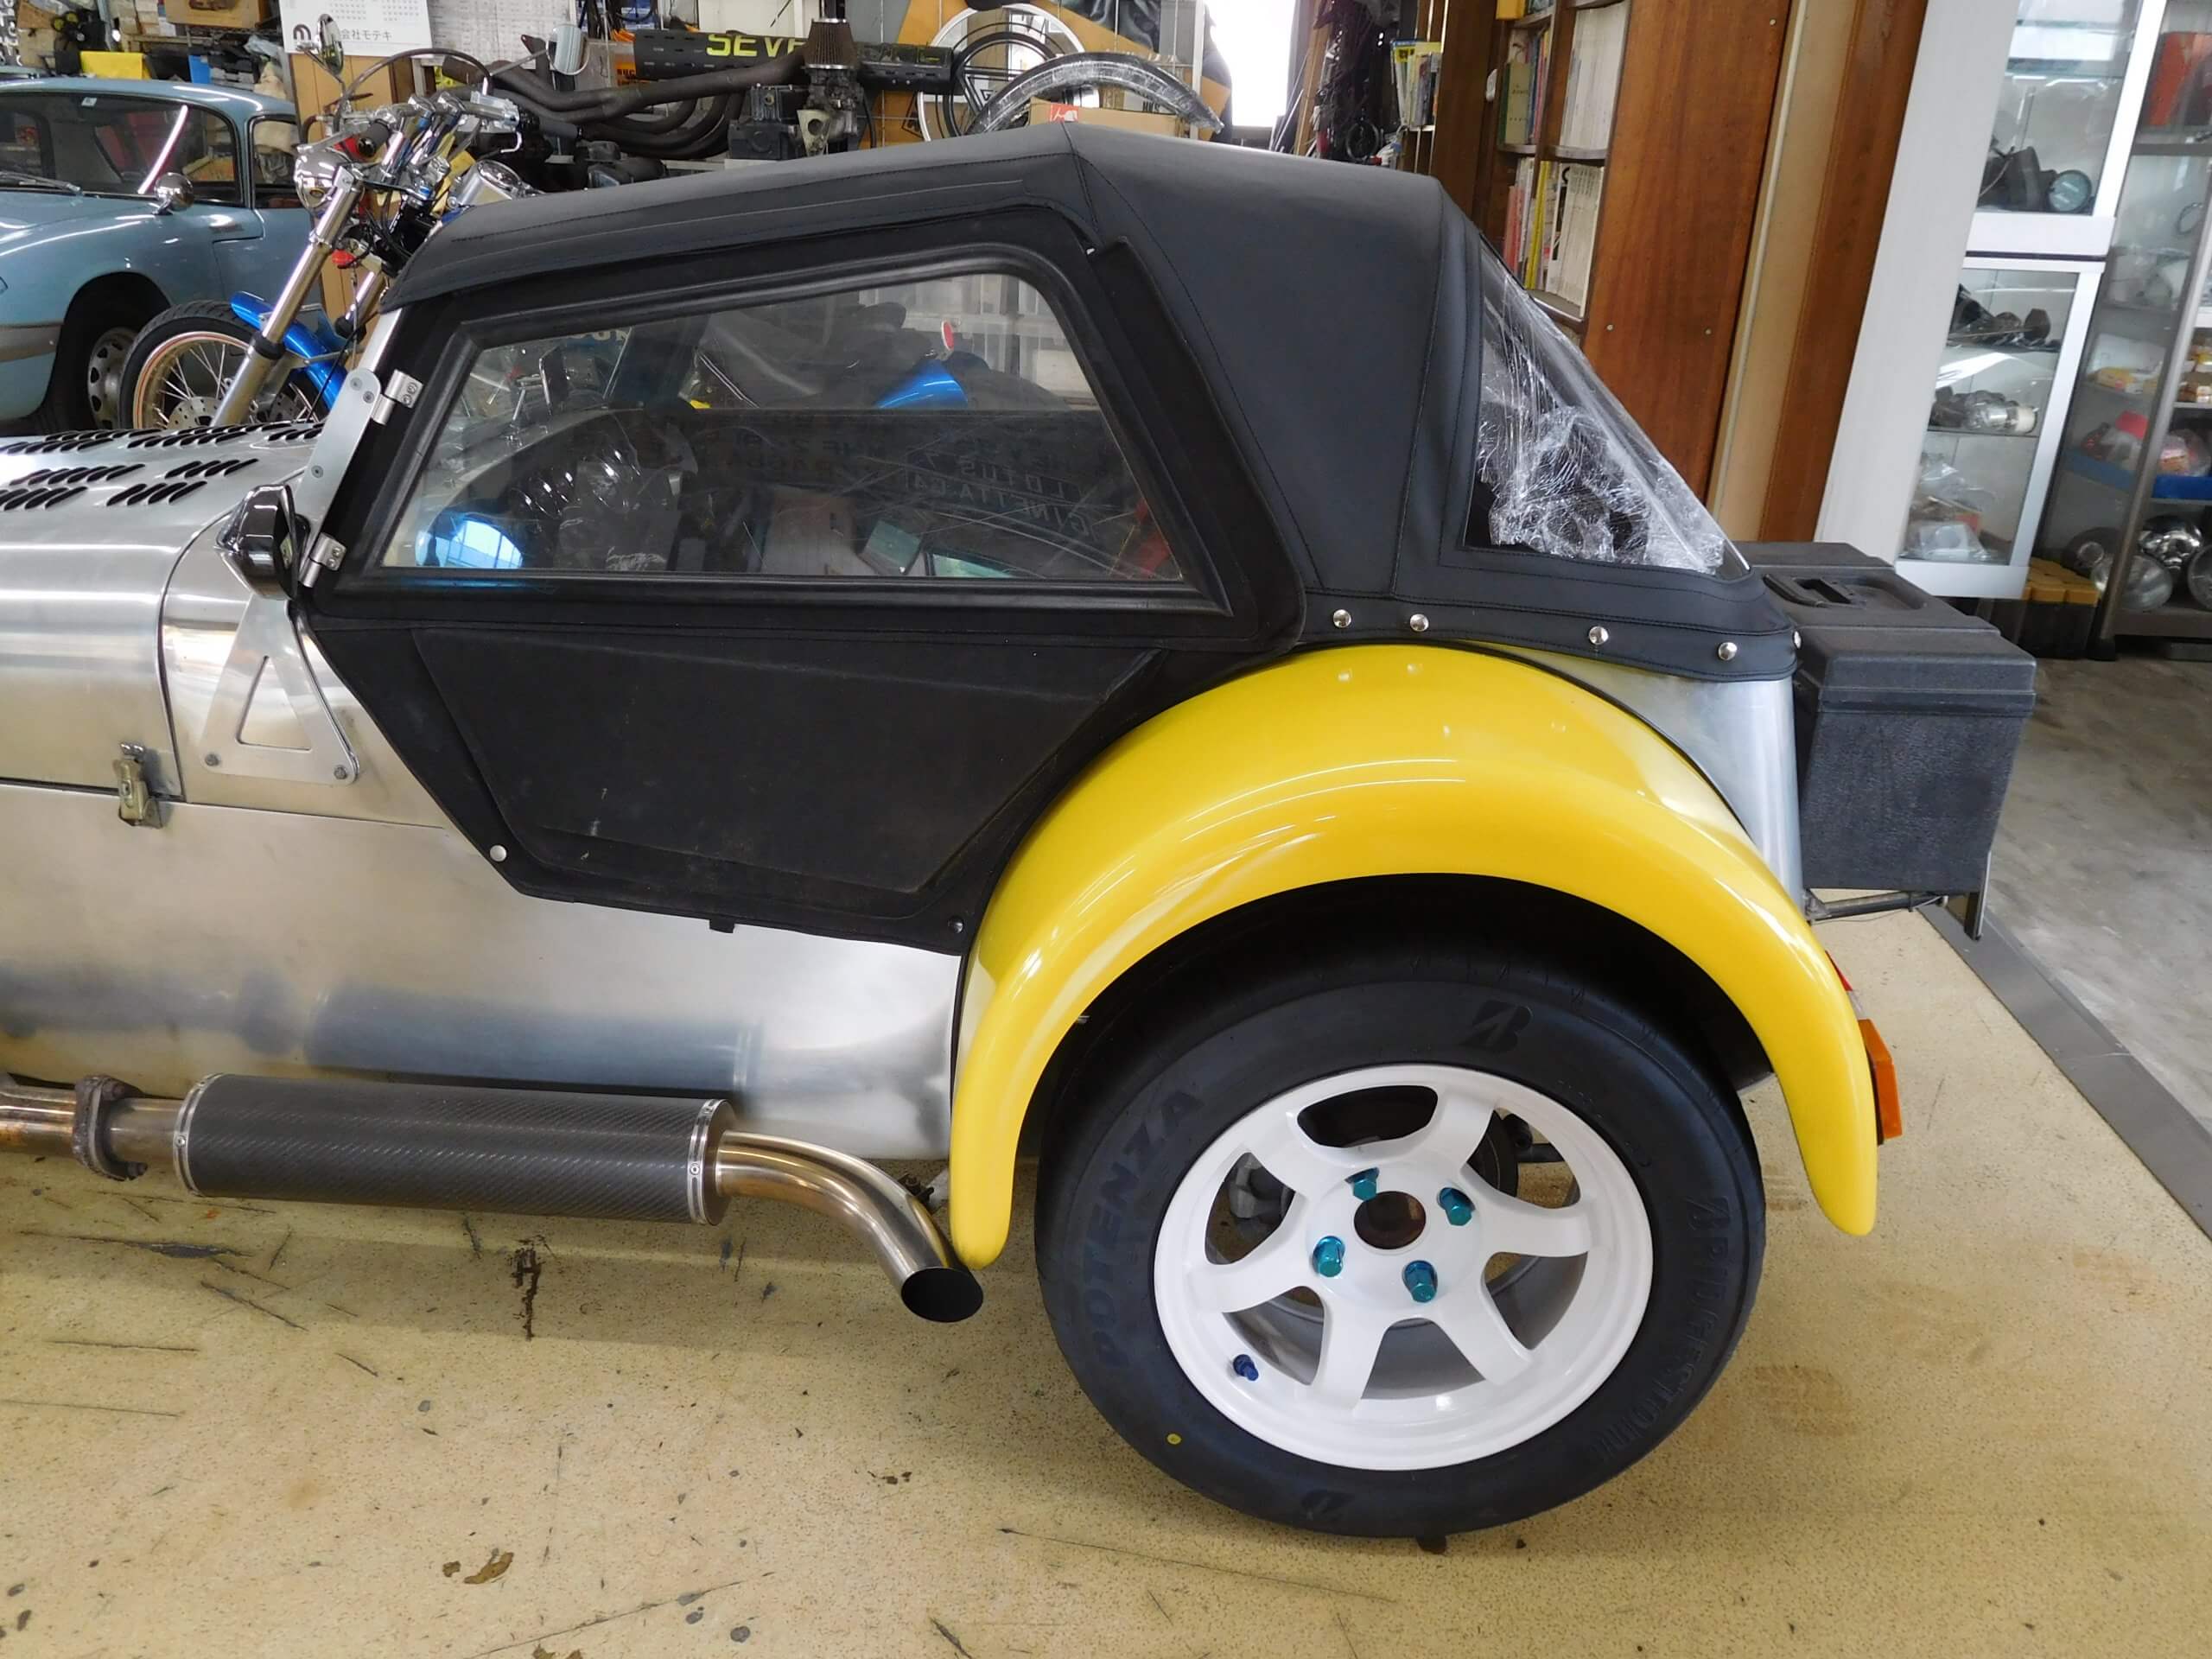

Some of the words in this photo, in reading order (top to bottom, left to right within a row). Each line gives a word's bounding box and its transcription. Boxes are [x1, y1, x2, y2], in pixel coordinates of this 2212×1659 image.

[340, 28, 392, 41] 会社モテキ
[1083, 1087, 1205, 1370] POTENZA
